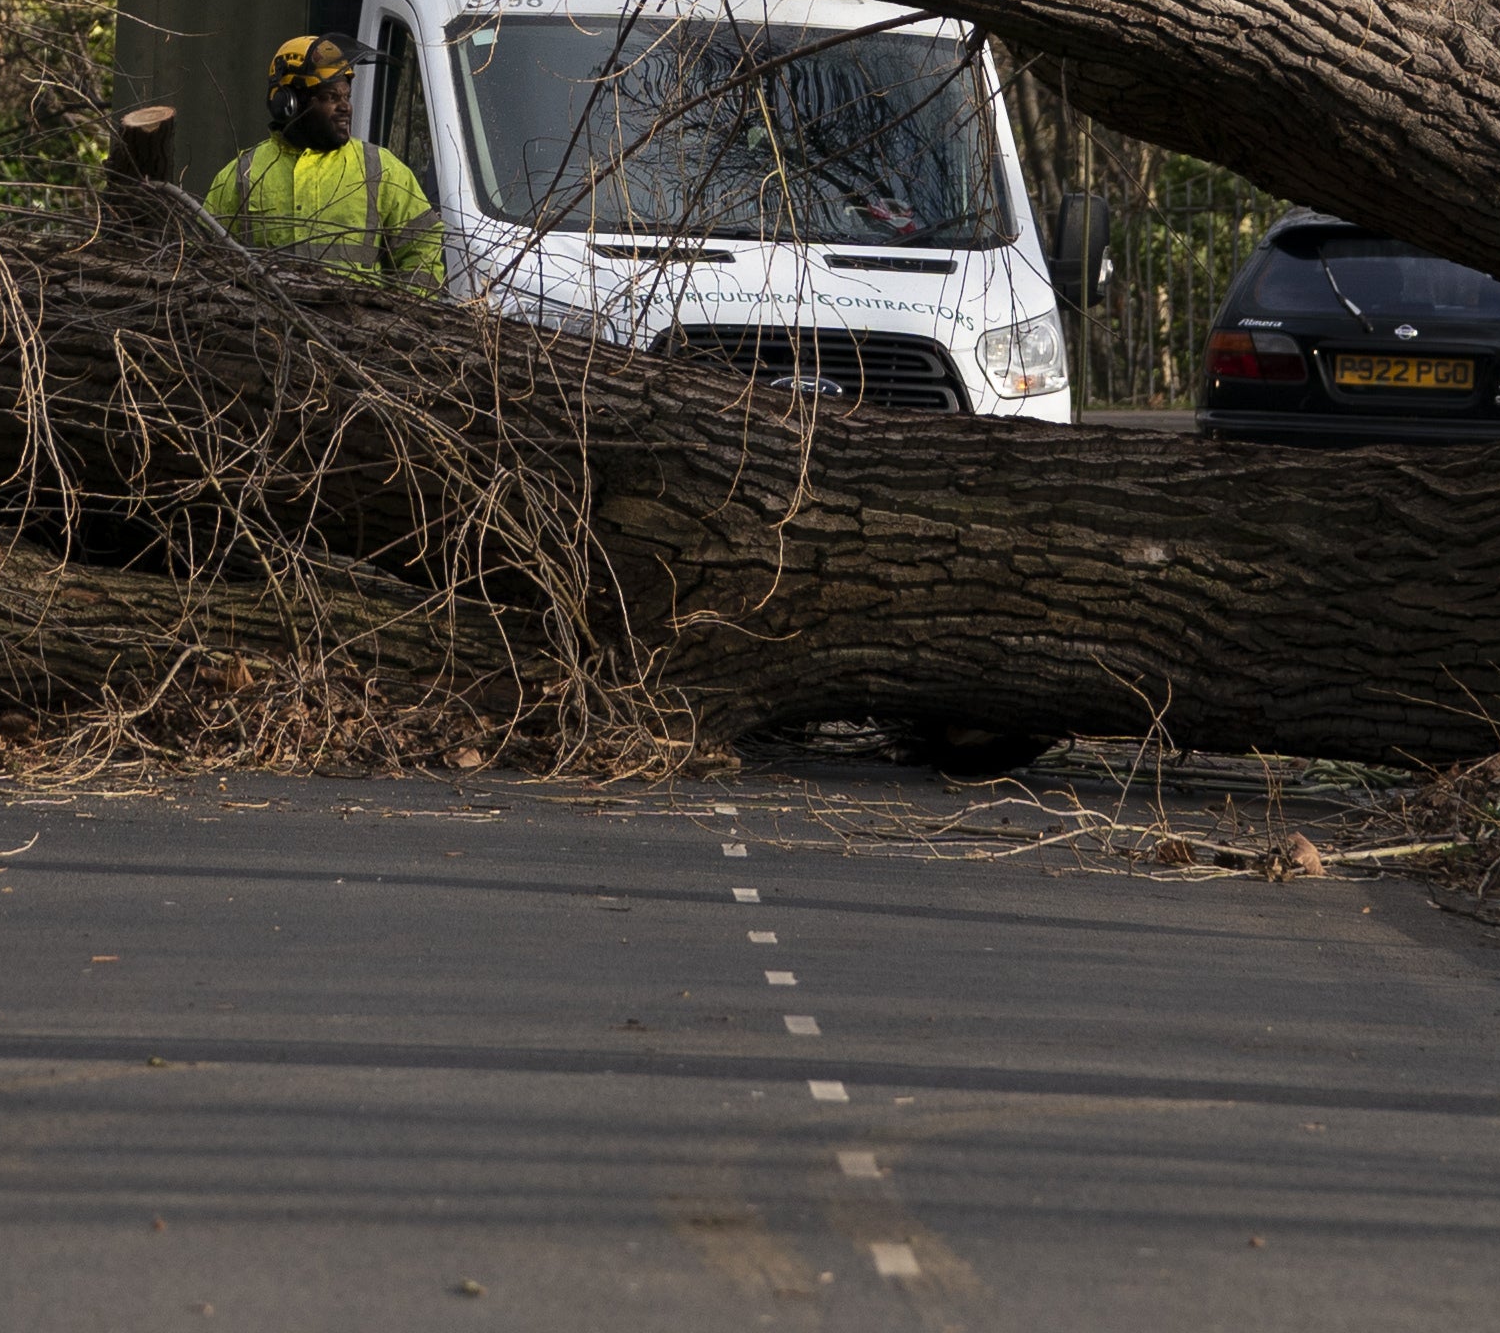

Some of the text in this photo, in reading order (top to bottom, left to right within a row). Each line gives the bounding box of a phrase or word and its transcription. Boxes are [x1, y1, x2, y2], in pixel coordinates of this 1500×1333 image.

[622, 291, 974, 331] ARBORICULTURAL CONTRACTORS
[1339, 357, 1469, 384] P922 PGO
